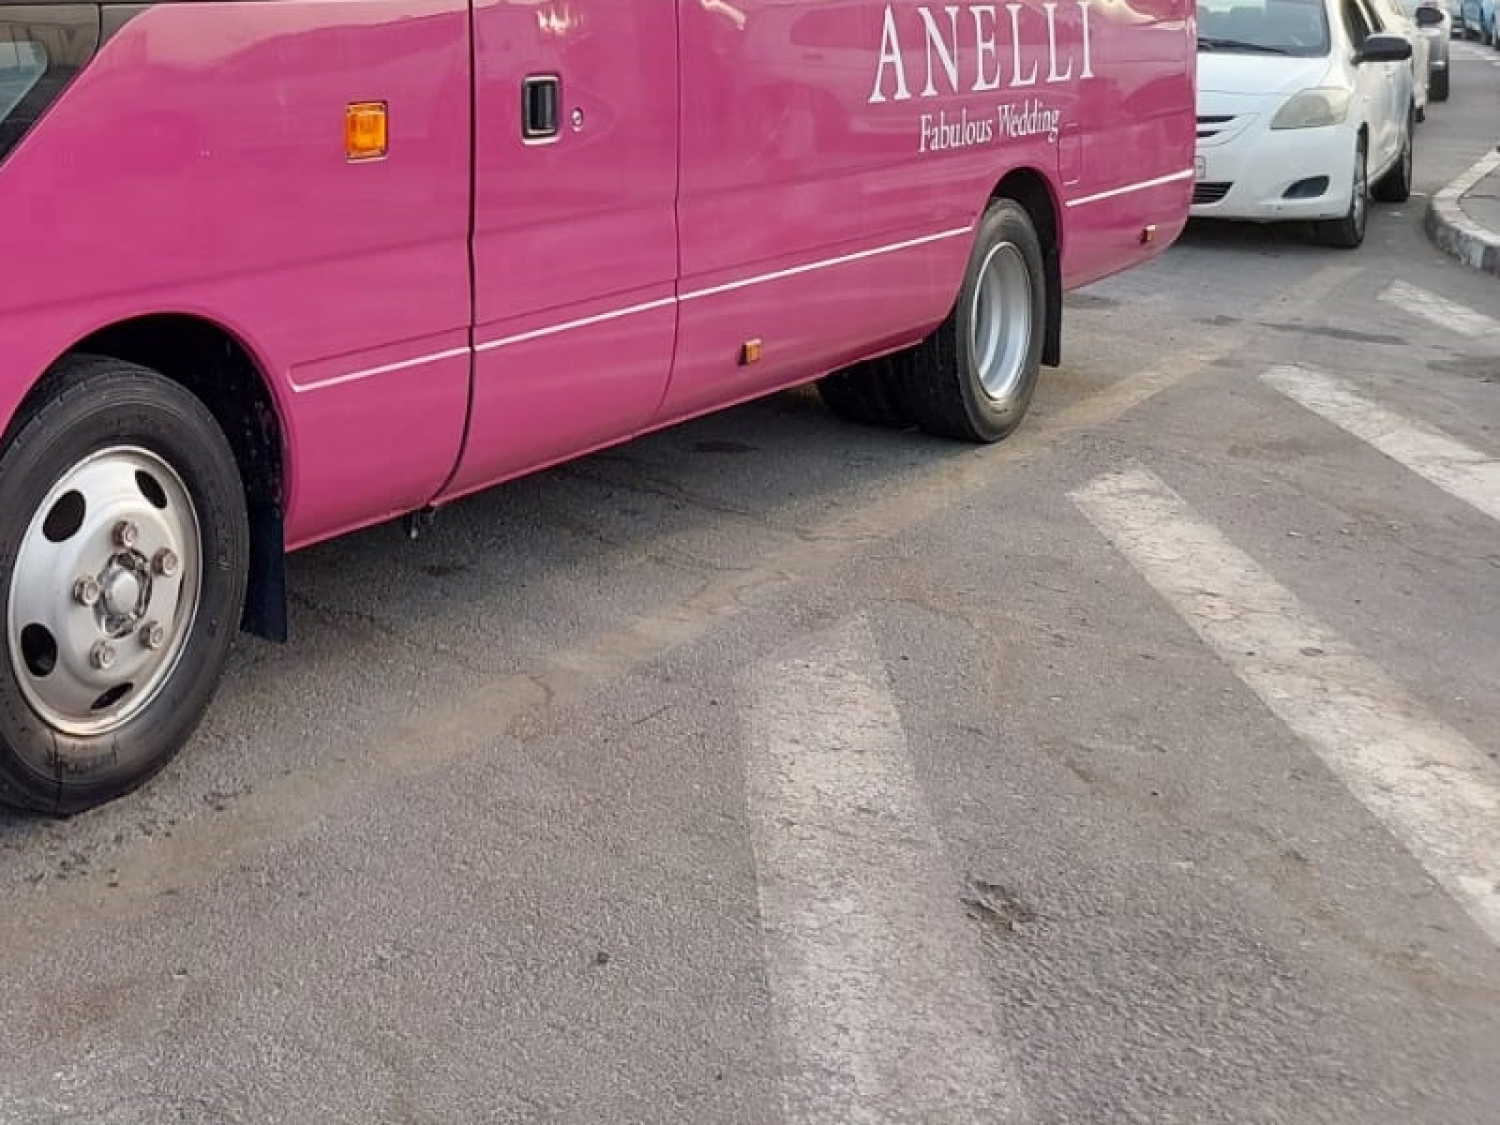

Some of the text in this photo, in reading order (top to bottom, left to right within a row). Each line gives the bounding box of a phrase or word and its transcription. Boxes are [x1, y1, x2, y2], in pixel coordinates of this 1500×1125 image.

[867, 0, 1095, 104] ANELLI
[917, 98, 1062, 153] Fabulous Wedding
